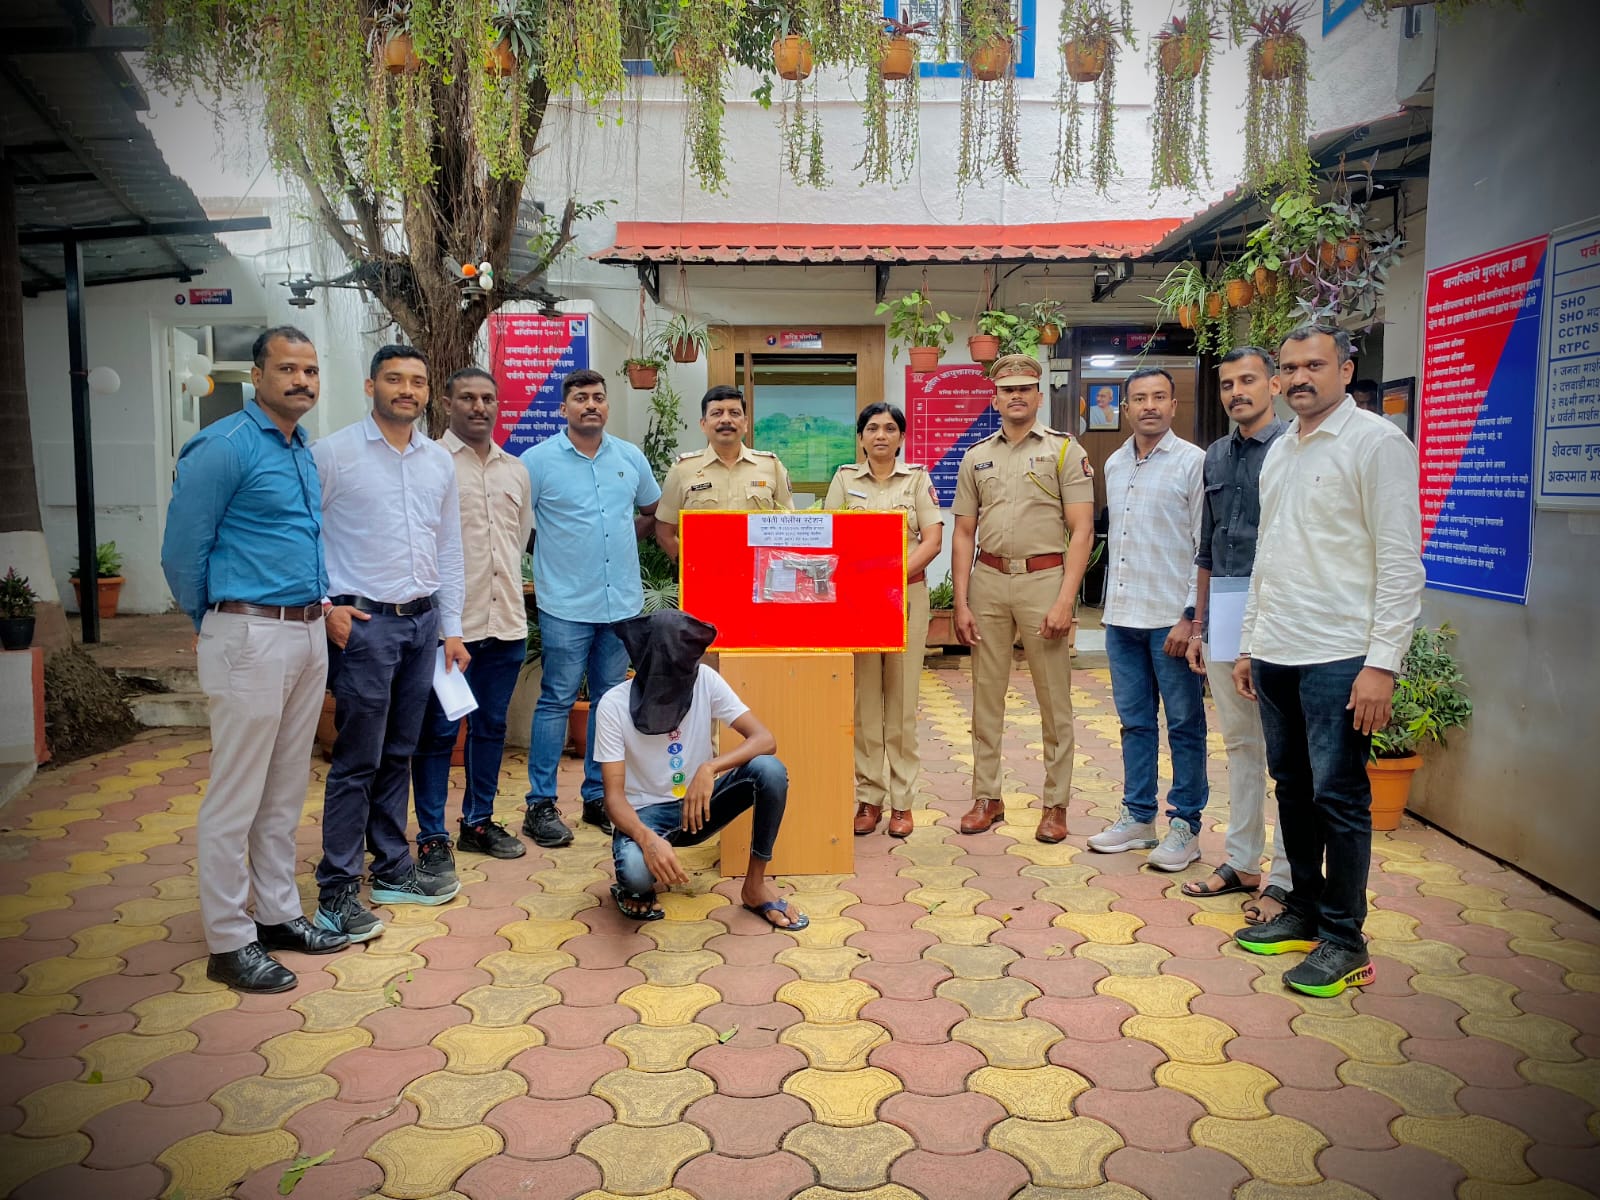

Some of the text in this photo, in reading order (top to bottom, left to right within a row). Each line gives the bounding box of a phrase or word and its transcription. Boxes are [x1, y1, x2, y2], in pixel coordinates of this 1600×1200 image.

[1580, 240, 1600, 258] पर्व
[1560, 295, 1586, 310] SHO
[1559, 310, 1584, 324] SHO
[1558, 322, 1599, 338] CCTNS
[1559, 340, 1590, 354] RTPC
[1557, 408, 1576, 422] पर्वती
[1552, 441, 1582, 457] शेवटचा
[1548, 470, 1587, 482] अकस्मात
[780, 515, 801, 524] पोलीस
[1344, 967, 1373, 985] NITRO
